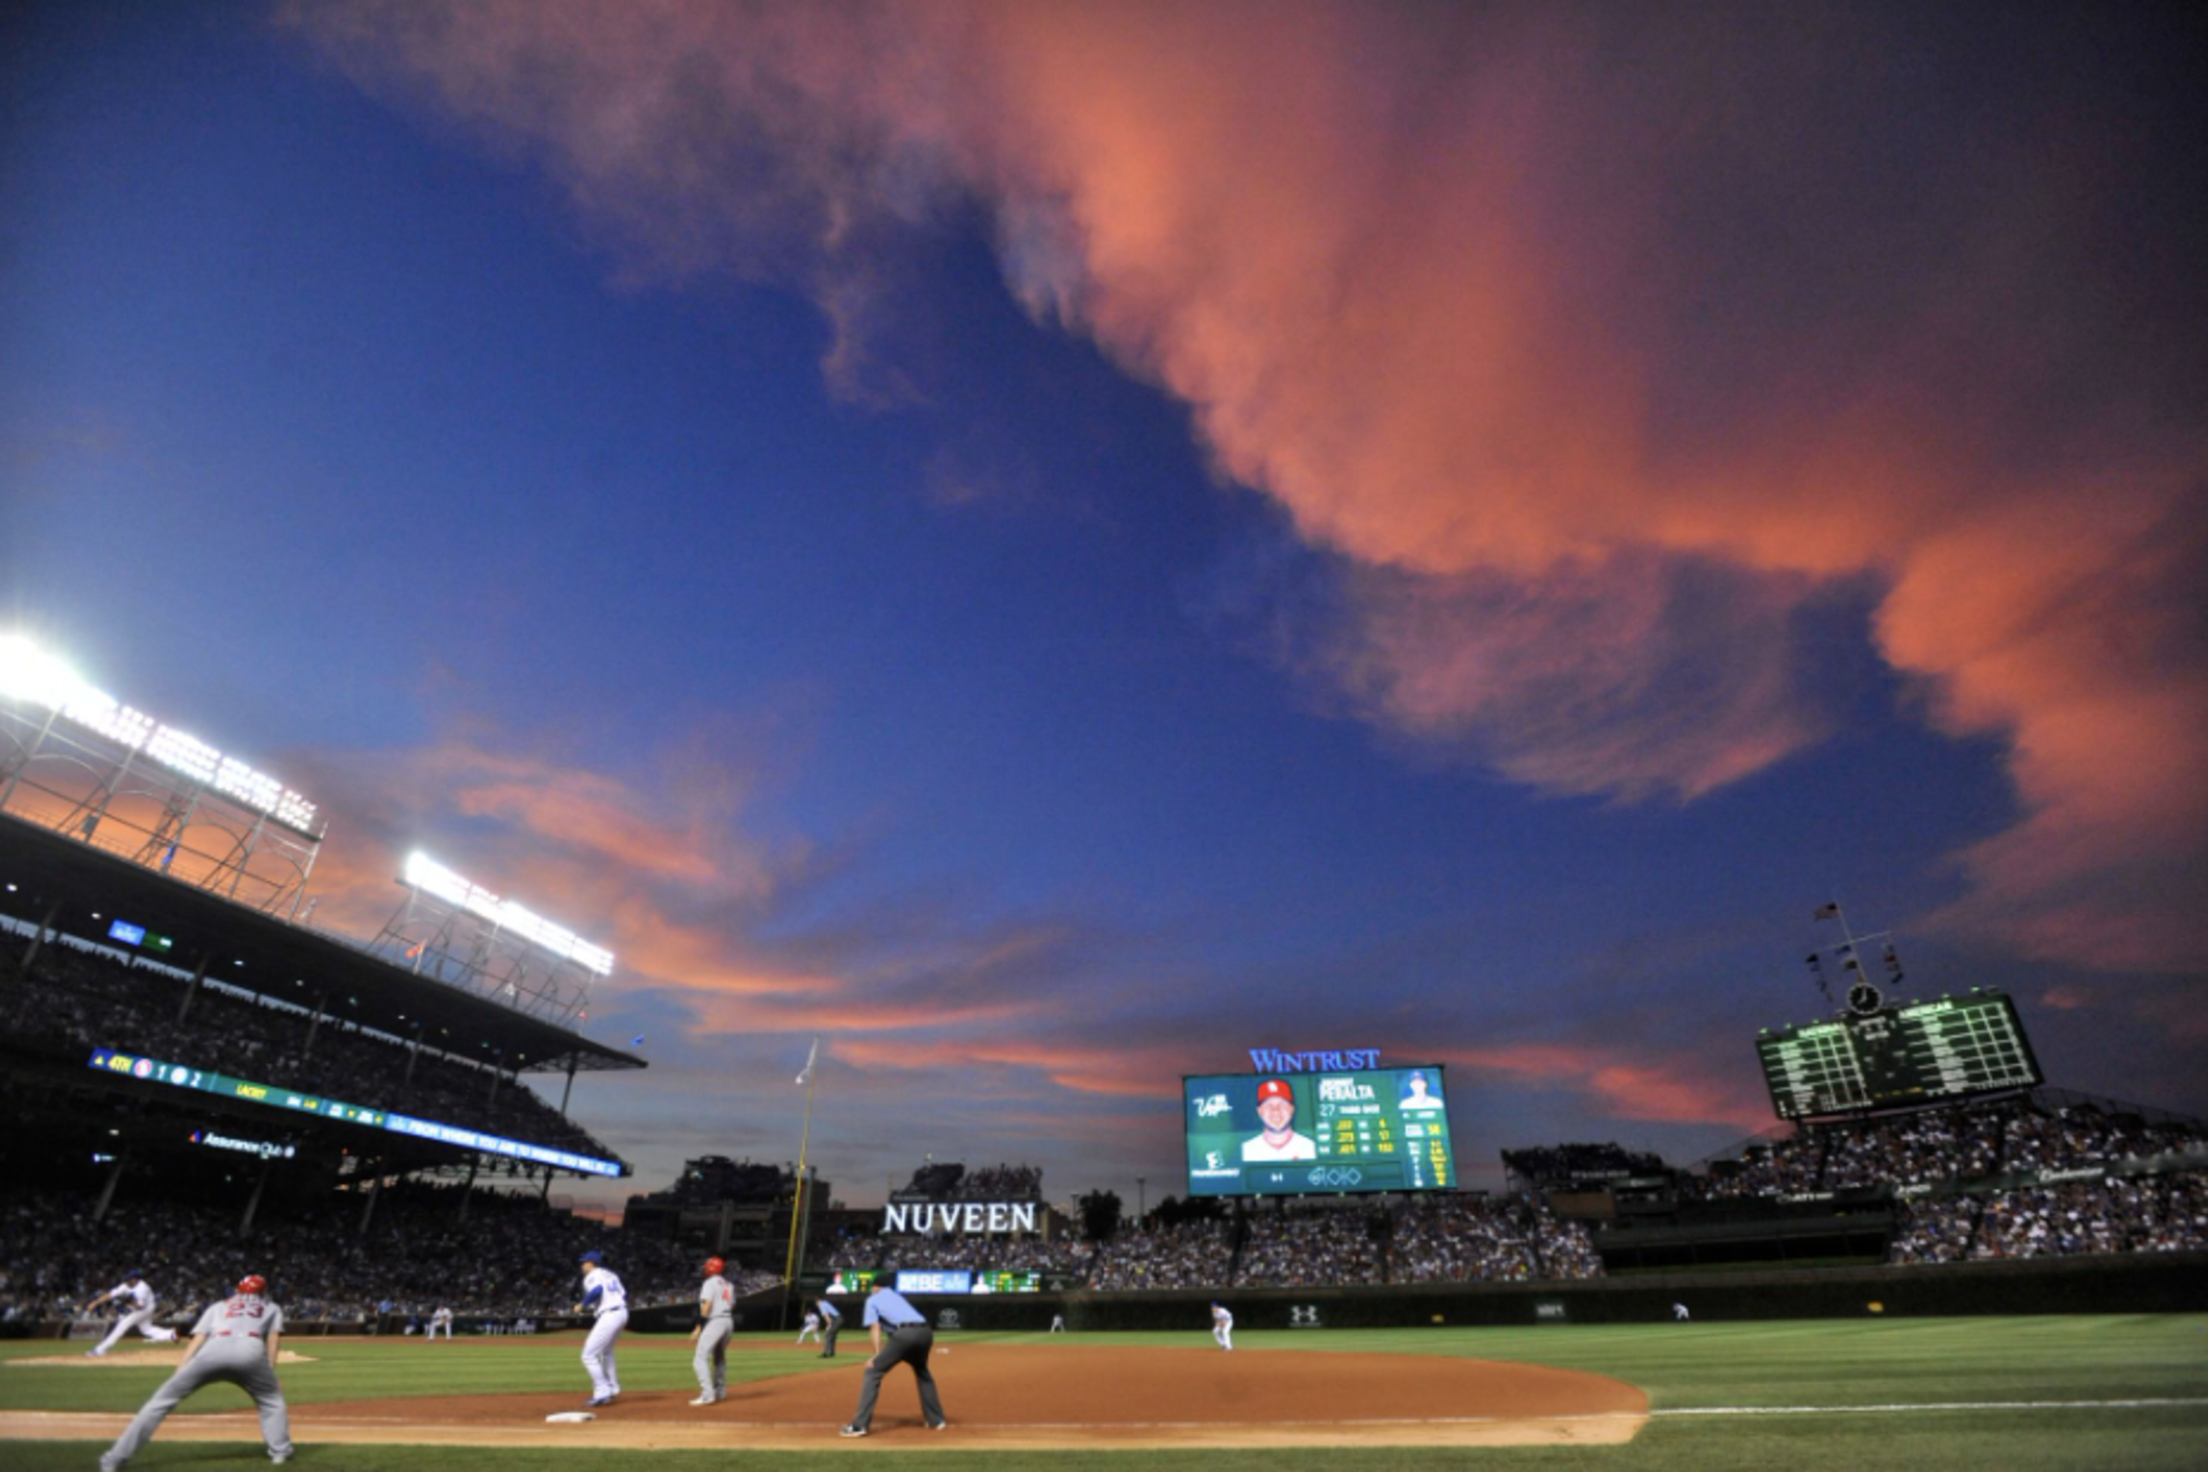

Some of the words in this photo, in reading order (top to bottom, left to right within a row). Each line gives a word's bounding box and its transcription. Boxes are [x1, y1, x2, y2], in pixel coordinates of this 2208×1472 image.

[158, 1065, 166, 1079] 1
[190, 1072, 201, 1088] 2
[1320, 1084, 1375, 1101] PERALTA
[1320, 1104, 1335, 1116] 27
[884, 1203, 1035, 1233] NUVEEN
[225, 1301, 264, 1318] 23
